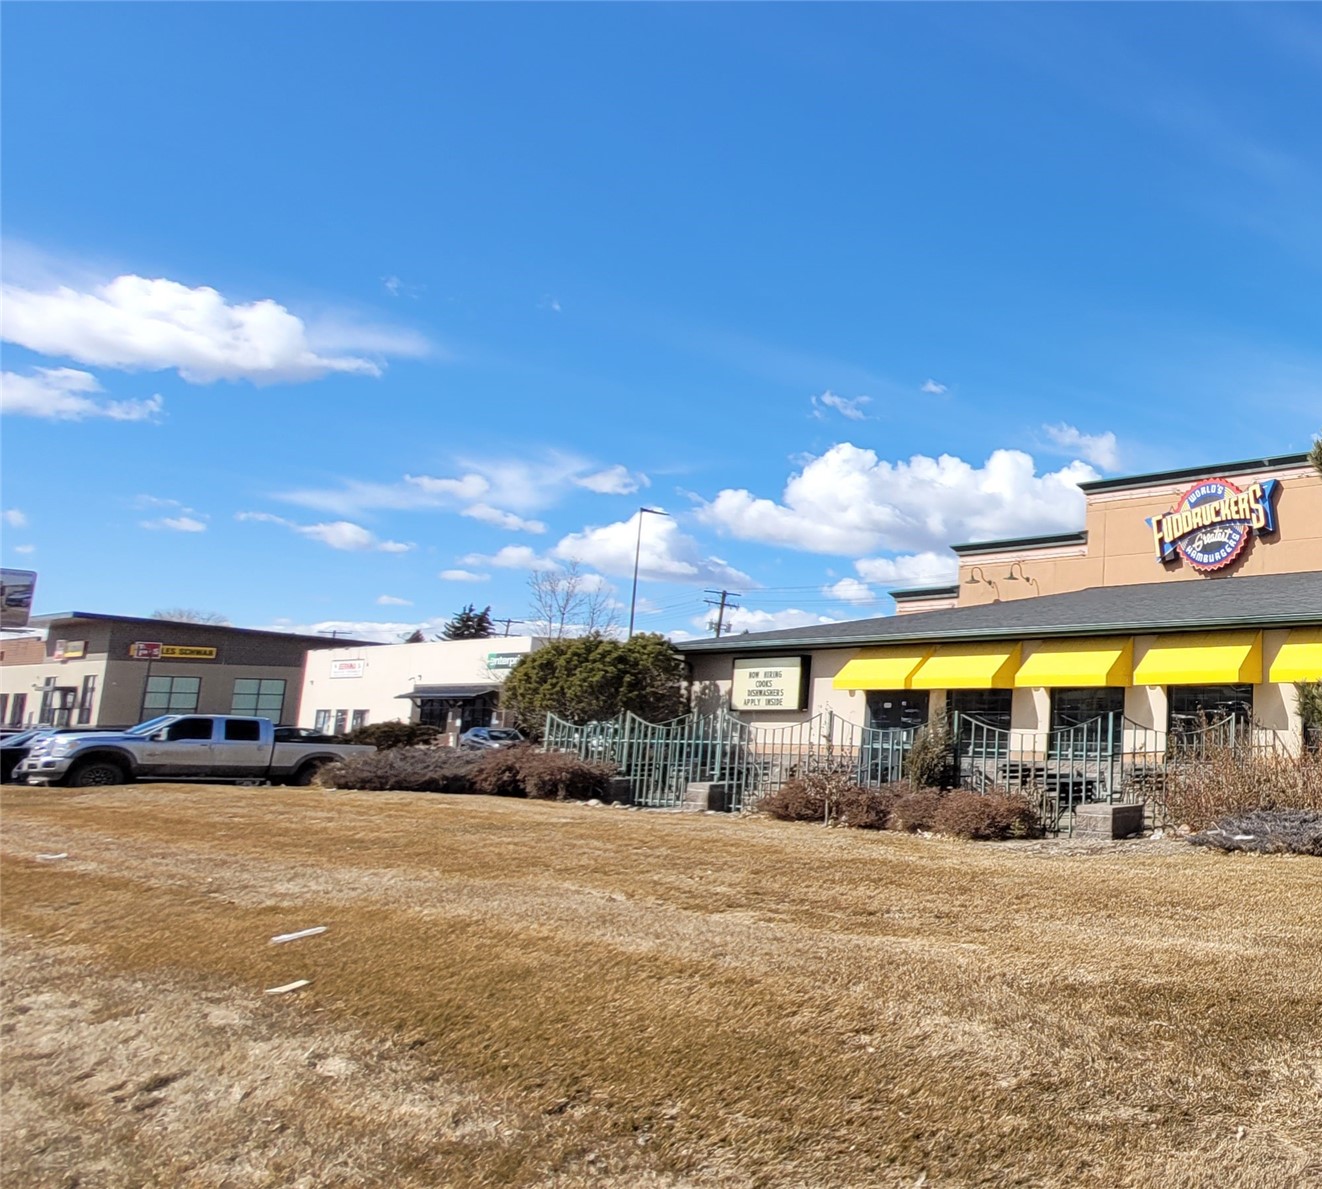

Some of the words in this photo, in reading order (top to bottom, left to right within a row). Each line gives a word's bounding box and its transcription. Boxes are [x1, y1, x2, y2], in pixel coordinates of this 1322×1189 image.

[1188, 484, 1224, 503] WORLD'S
[1152, 483, 1265, 560] FUDDRUCKERS
[1185, 532, 1240, 563] HAMBURGERS
[178, 648, 214, 656] SCHWAB
[749, 671, 760, 679] NOW
[764, 671, 783, 679] HIRING
[755, 680, 773, 688] COOKS
[747, 689, 784, 697] DISHWASHERS
[743, 698, 761, 706] APPLY
[765, 698, 783, 706] INSIDE
